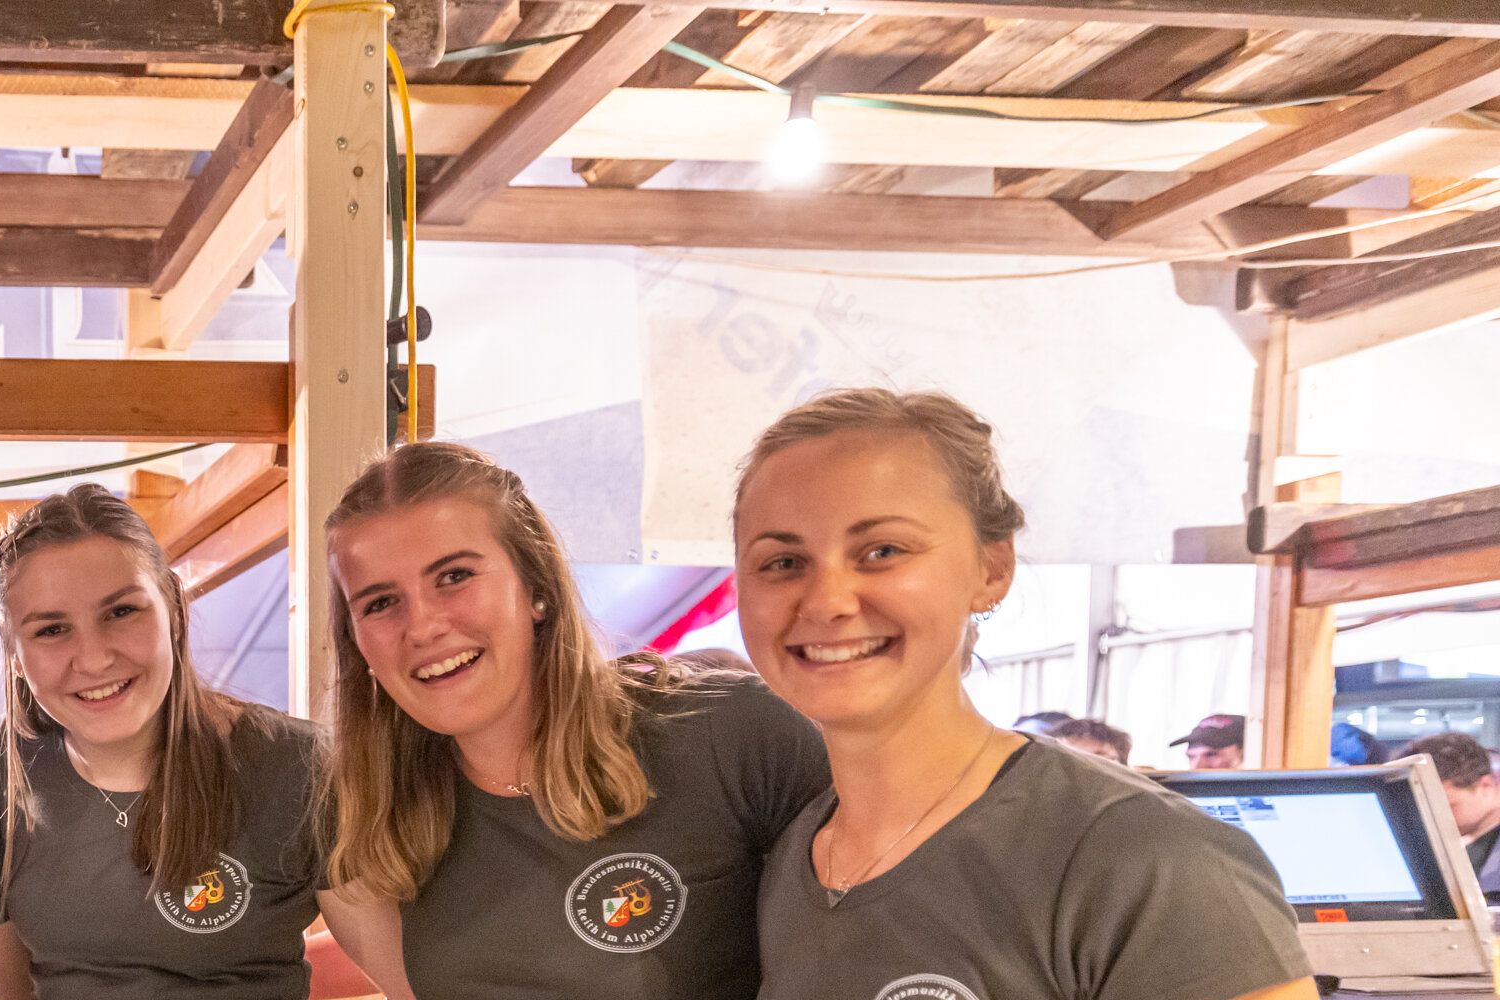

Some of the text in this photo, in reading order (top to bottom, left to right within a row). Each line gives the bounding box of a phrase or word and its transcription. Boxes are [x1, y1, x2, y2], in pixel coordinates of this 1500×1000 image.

[576, 860, 672, 901] Bundesmusikkapelle
[163, 891, 243, 926] Reith im Alpbachtal
[577, 899, 676, 943] Reith im Alpbachtal
